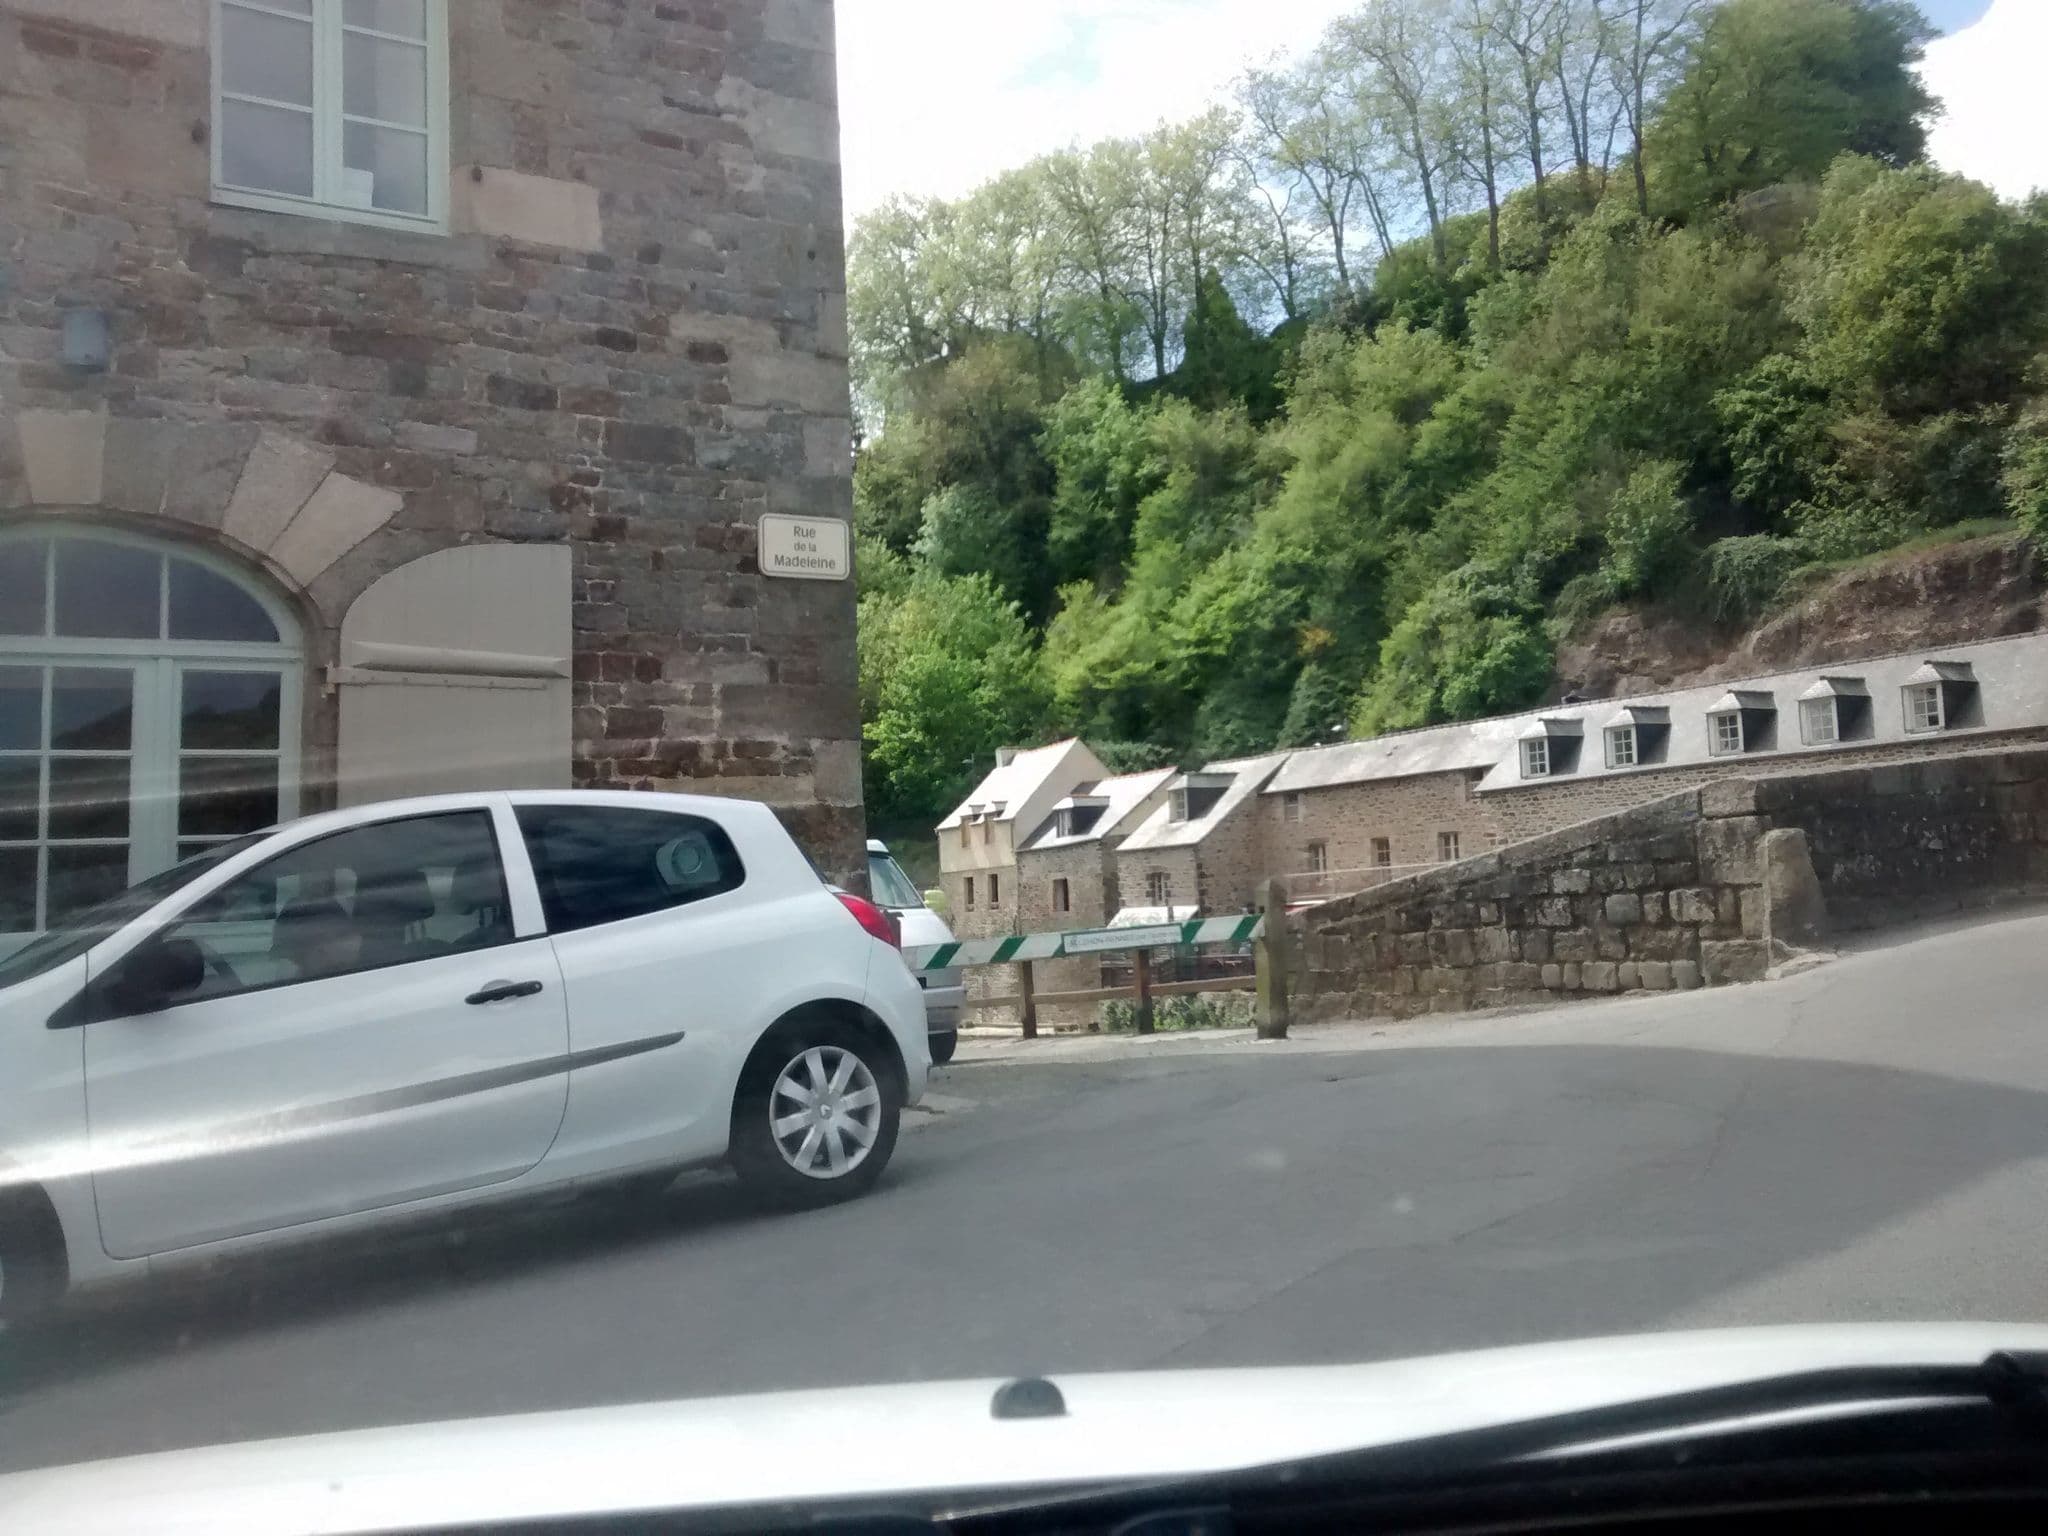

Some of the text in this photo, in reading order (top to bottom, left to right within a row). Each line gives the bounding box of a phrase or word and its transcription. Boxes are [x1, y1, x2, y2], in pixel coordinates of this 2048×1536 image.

[793, 525, 816, 538] Rue
[793, 541, 816, 552] de la
[774, 554, 836, 569] Madeleine
